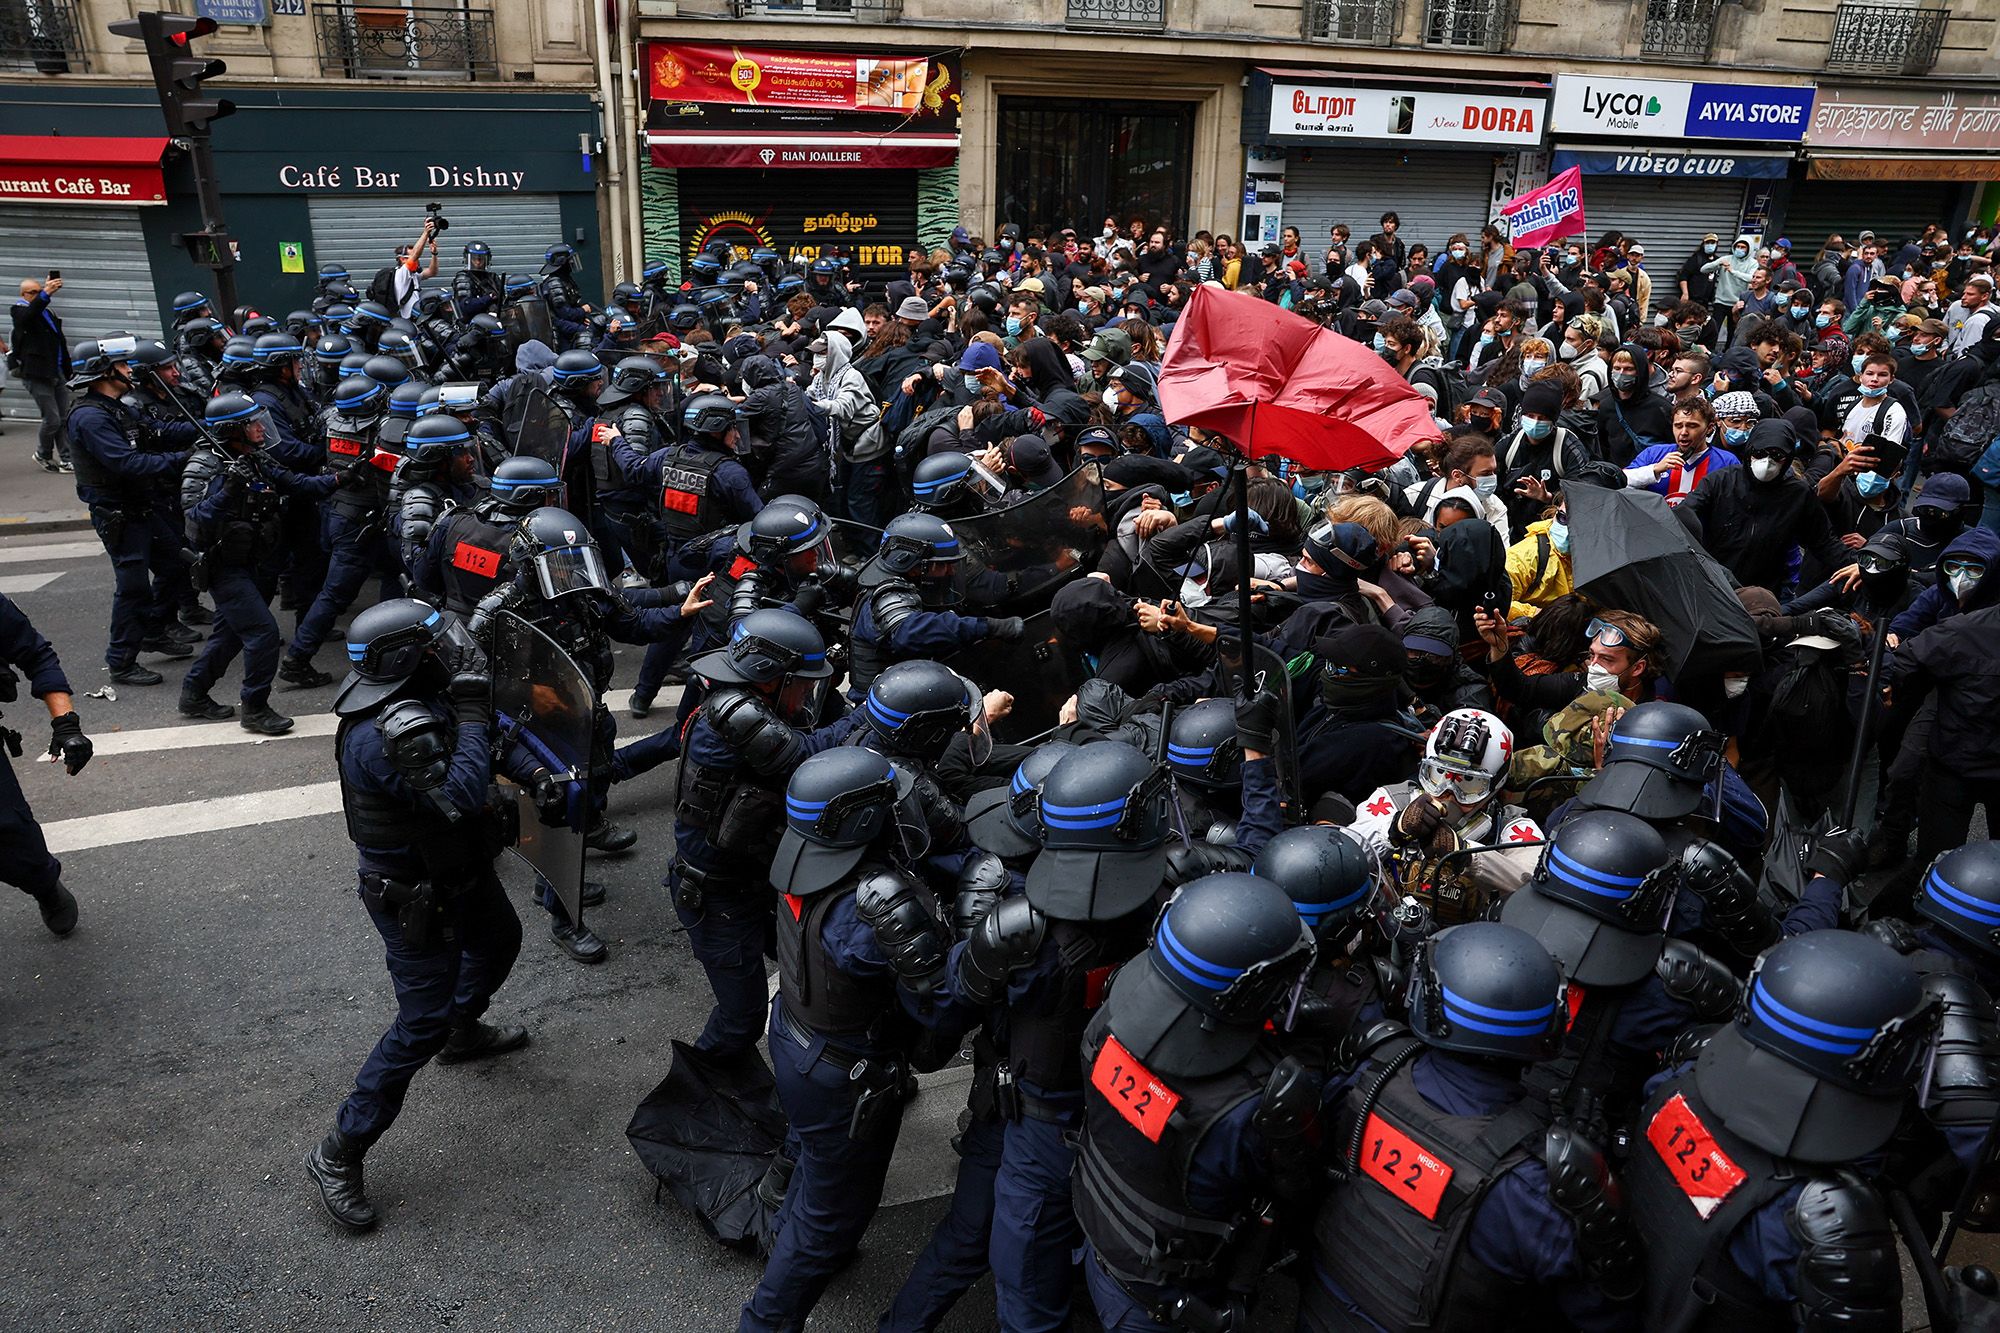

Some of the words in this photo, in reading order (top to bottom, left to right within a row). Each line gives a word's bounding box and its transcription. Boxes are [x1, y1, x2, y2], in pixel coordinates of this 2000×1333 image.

[223, 8, 255, 18] DENIS
[275, 0, 303, 14] 212
[826, 79, 844, 89] 50%
[1583, 86, 1644, 119] Lyca
[1699, 102, 1745, 122] AYYA
[1748, 104, 1802, 124] STORE
[1428, 116, 1460, 129] New
[1462, 105, 1534, 133] DORA
[1606, 117, 1639, 130] Mobile
[1952, 95, 2000, 144] poin
[782, 151, 806, 162] RIAN
[809, 151, 862, 162] JOAILLERIE
[1615, 155, 1680, 174] VIDEO
[1683, 157, 1736, 175] CLUB
[0, 178, 51, 193] urant
[54, 178, 95, 194] Café
[99, 179, 131, 195] Bar
[279, 165, 341, 188] Café
[353, 166, 400, 188] Bar
[427, 166, 525, 191] Dishny
[859, 245, 903, 266] D'OR
[663, 468, 705, 487] POLICE
[466, 552, 487, 568] 112
[1110, 1065, 1152, 1116] 122
[1147, 1081, 1167, 1100] NRBC
[1668, 1125, 1711, 1182] 123
[1709, 1151, 1731, 1173] NRBC
[1372, 1138, 1422, 1191] 122
[1417, 1153, 1440, 1172] NRBC
[1439, 1168, 1446, 1177] 1
